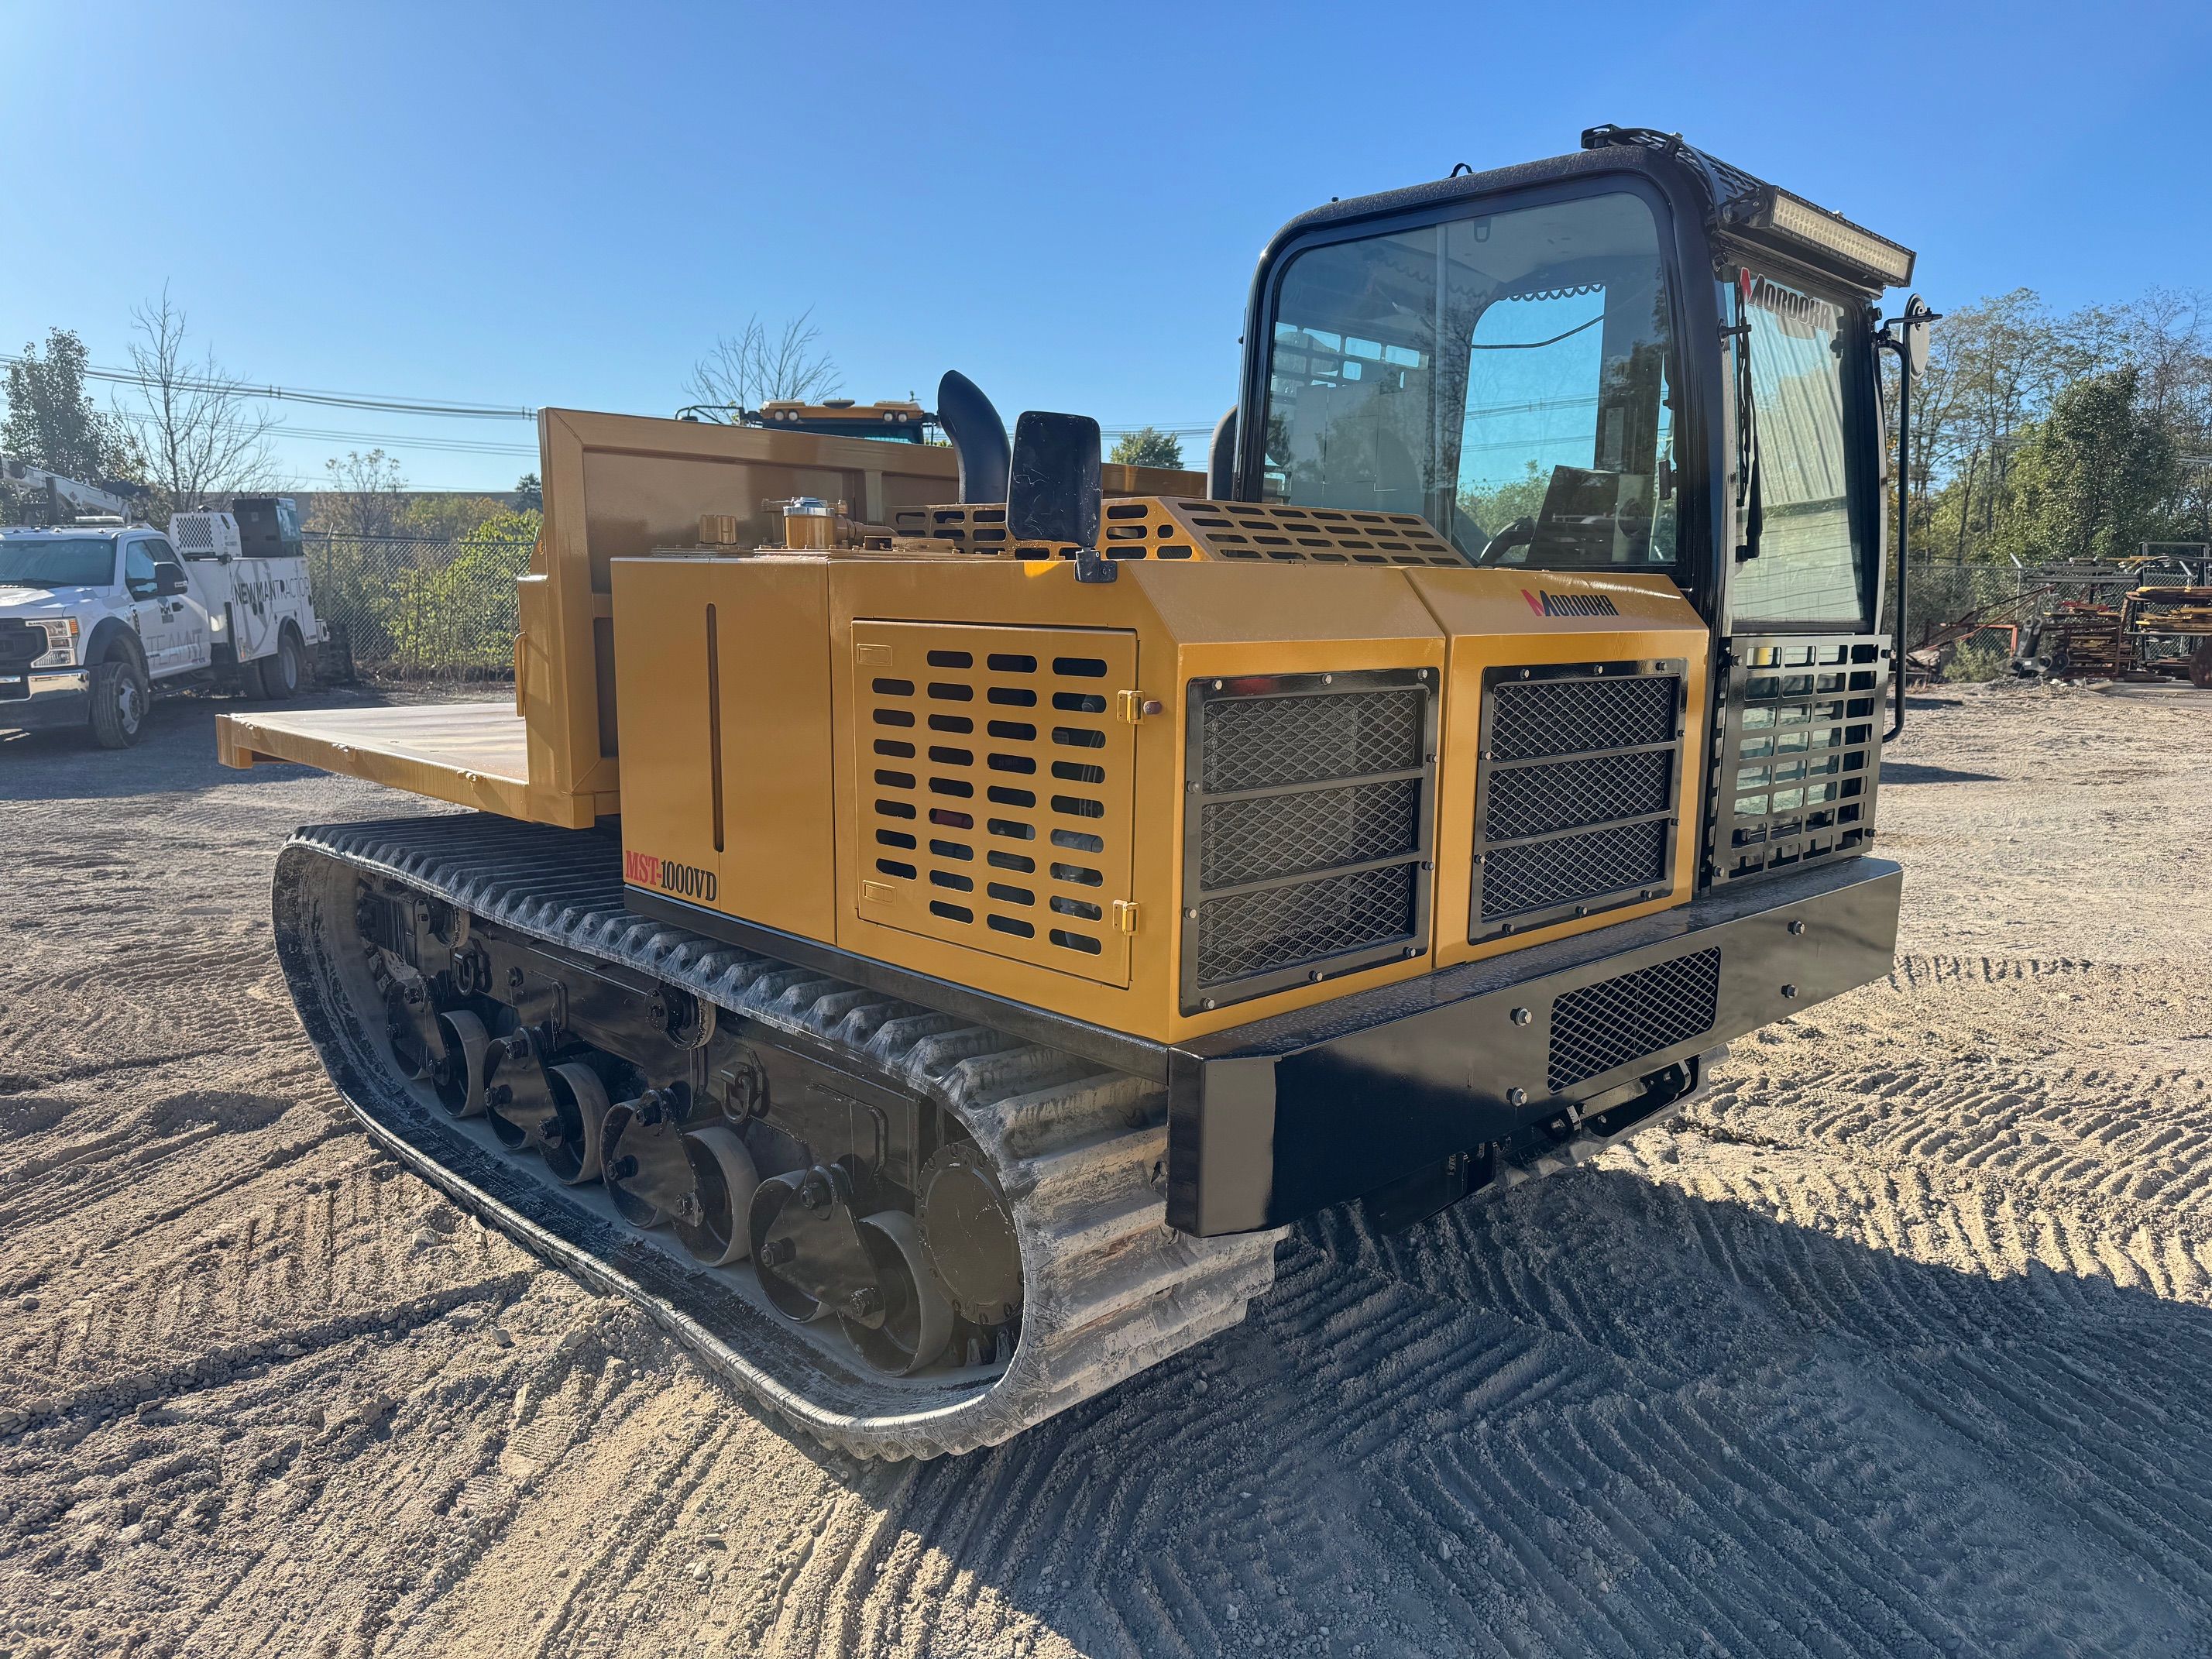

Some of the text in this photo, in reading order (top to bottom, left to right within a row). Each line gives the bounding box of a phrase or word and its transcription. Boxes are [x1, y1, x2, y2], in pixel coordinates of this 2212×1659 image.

[1740, 267, 1830, 331] MOROOKA
[1520, 589, 1620, 617] MOROOKA
[626, 850, 716, 901] MST-1000VD
